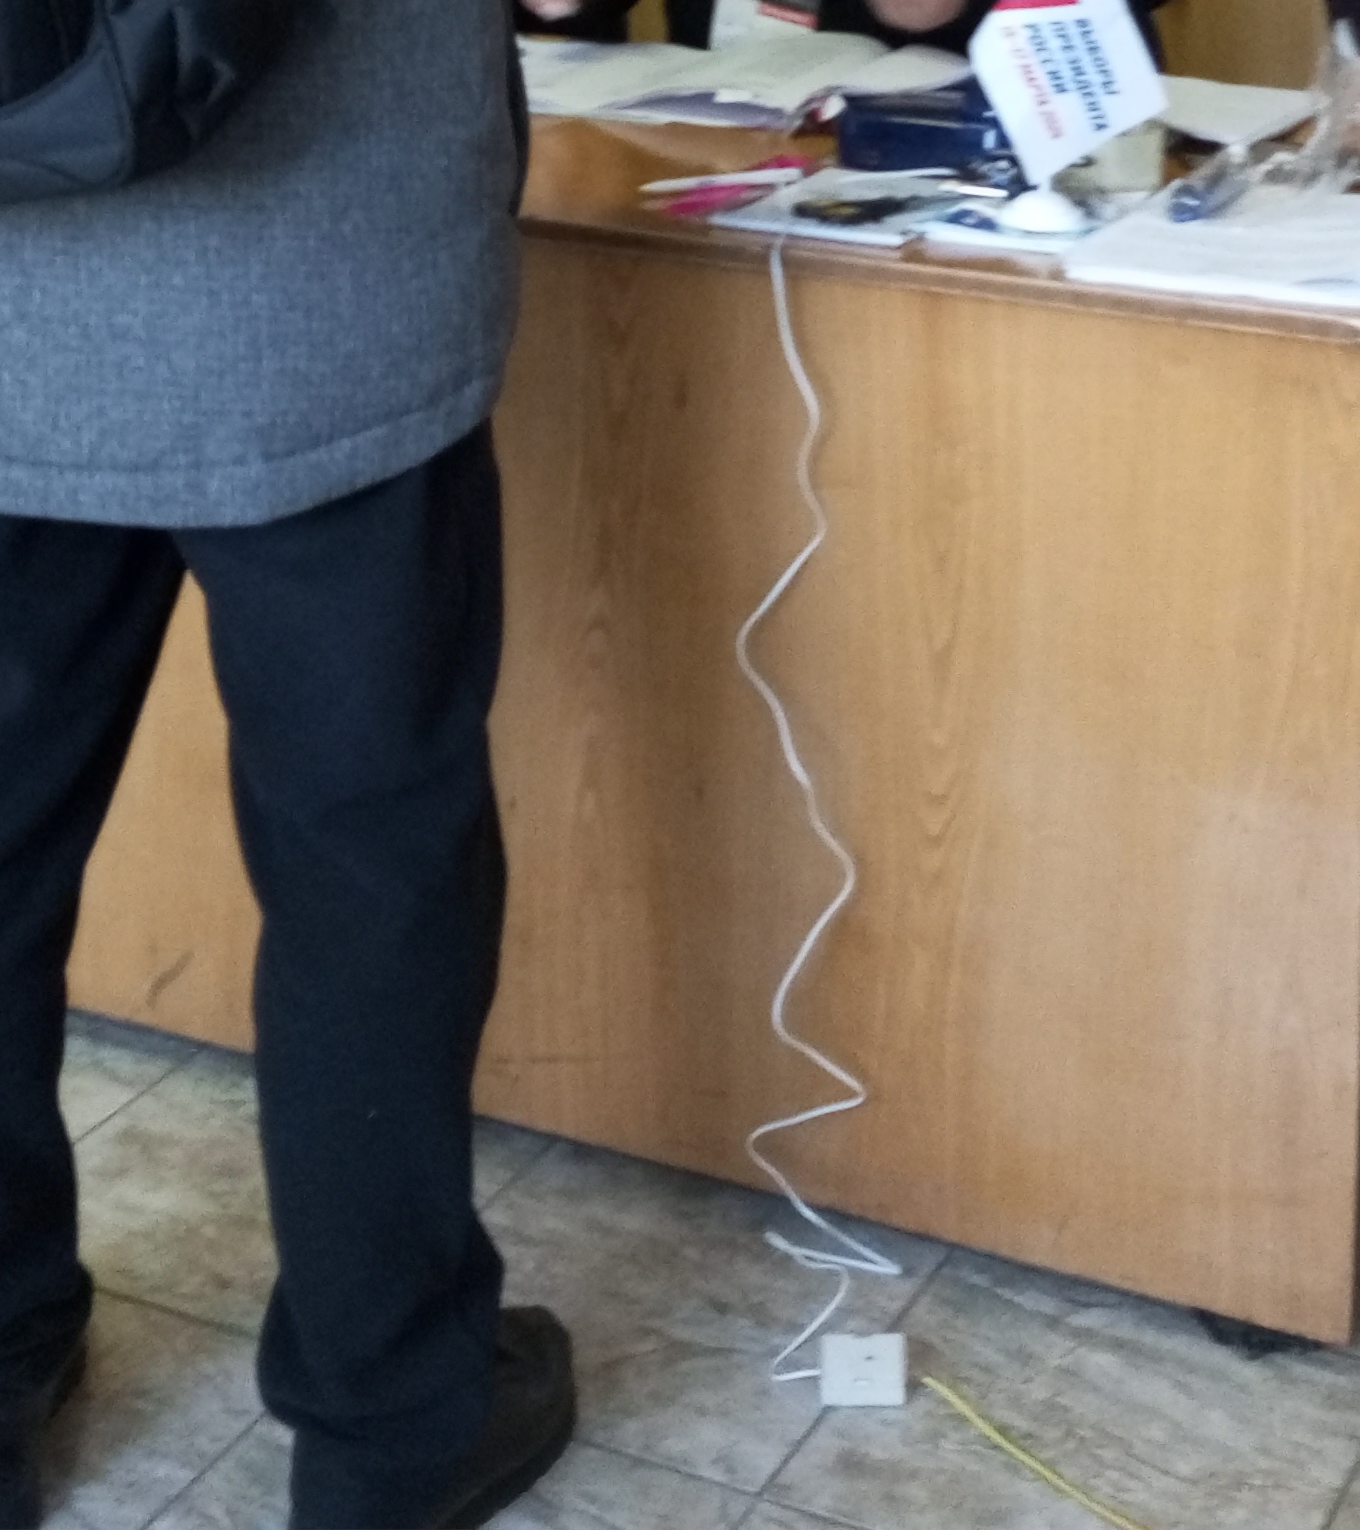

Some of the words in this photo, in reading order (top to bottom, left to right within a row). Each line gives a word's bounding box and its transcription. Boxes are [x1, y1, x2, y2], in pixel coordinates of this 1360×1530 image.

[1024, 24, 1069, 93] РОССИИ
[1049, 21, 1109, 131] ПРЕЗИДЕНТА
[1074, 19, 1120, 95] ВЫБОРЫ
